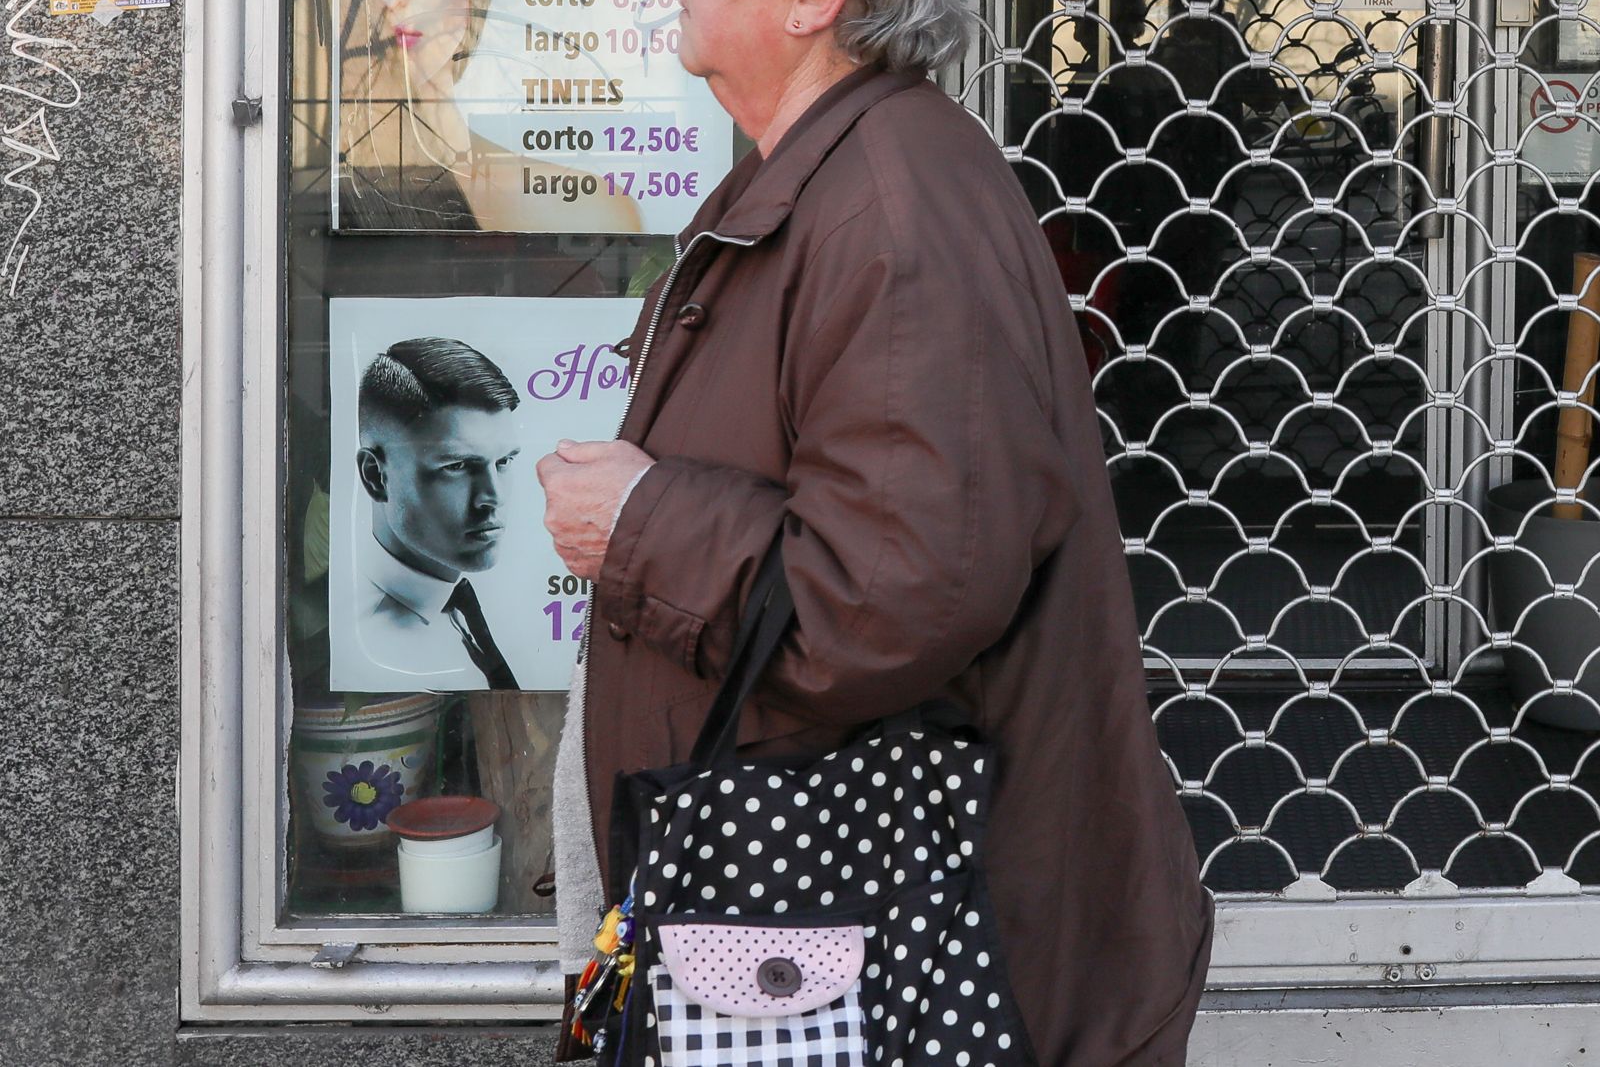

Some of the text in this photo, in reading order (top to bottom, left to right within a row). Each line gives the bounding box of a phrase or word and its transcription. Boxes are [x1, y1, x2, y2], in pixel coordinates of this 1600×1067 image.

[524, 24, 599, 61] largo
[521, 78, 625, 106] TINTES
[522, 125, 699, 156] corto 12,50€
[522, 168, 699, 202] largo 17,50€
